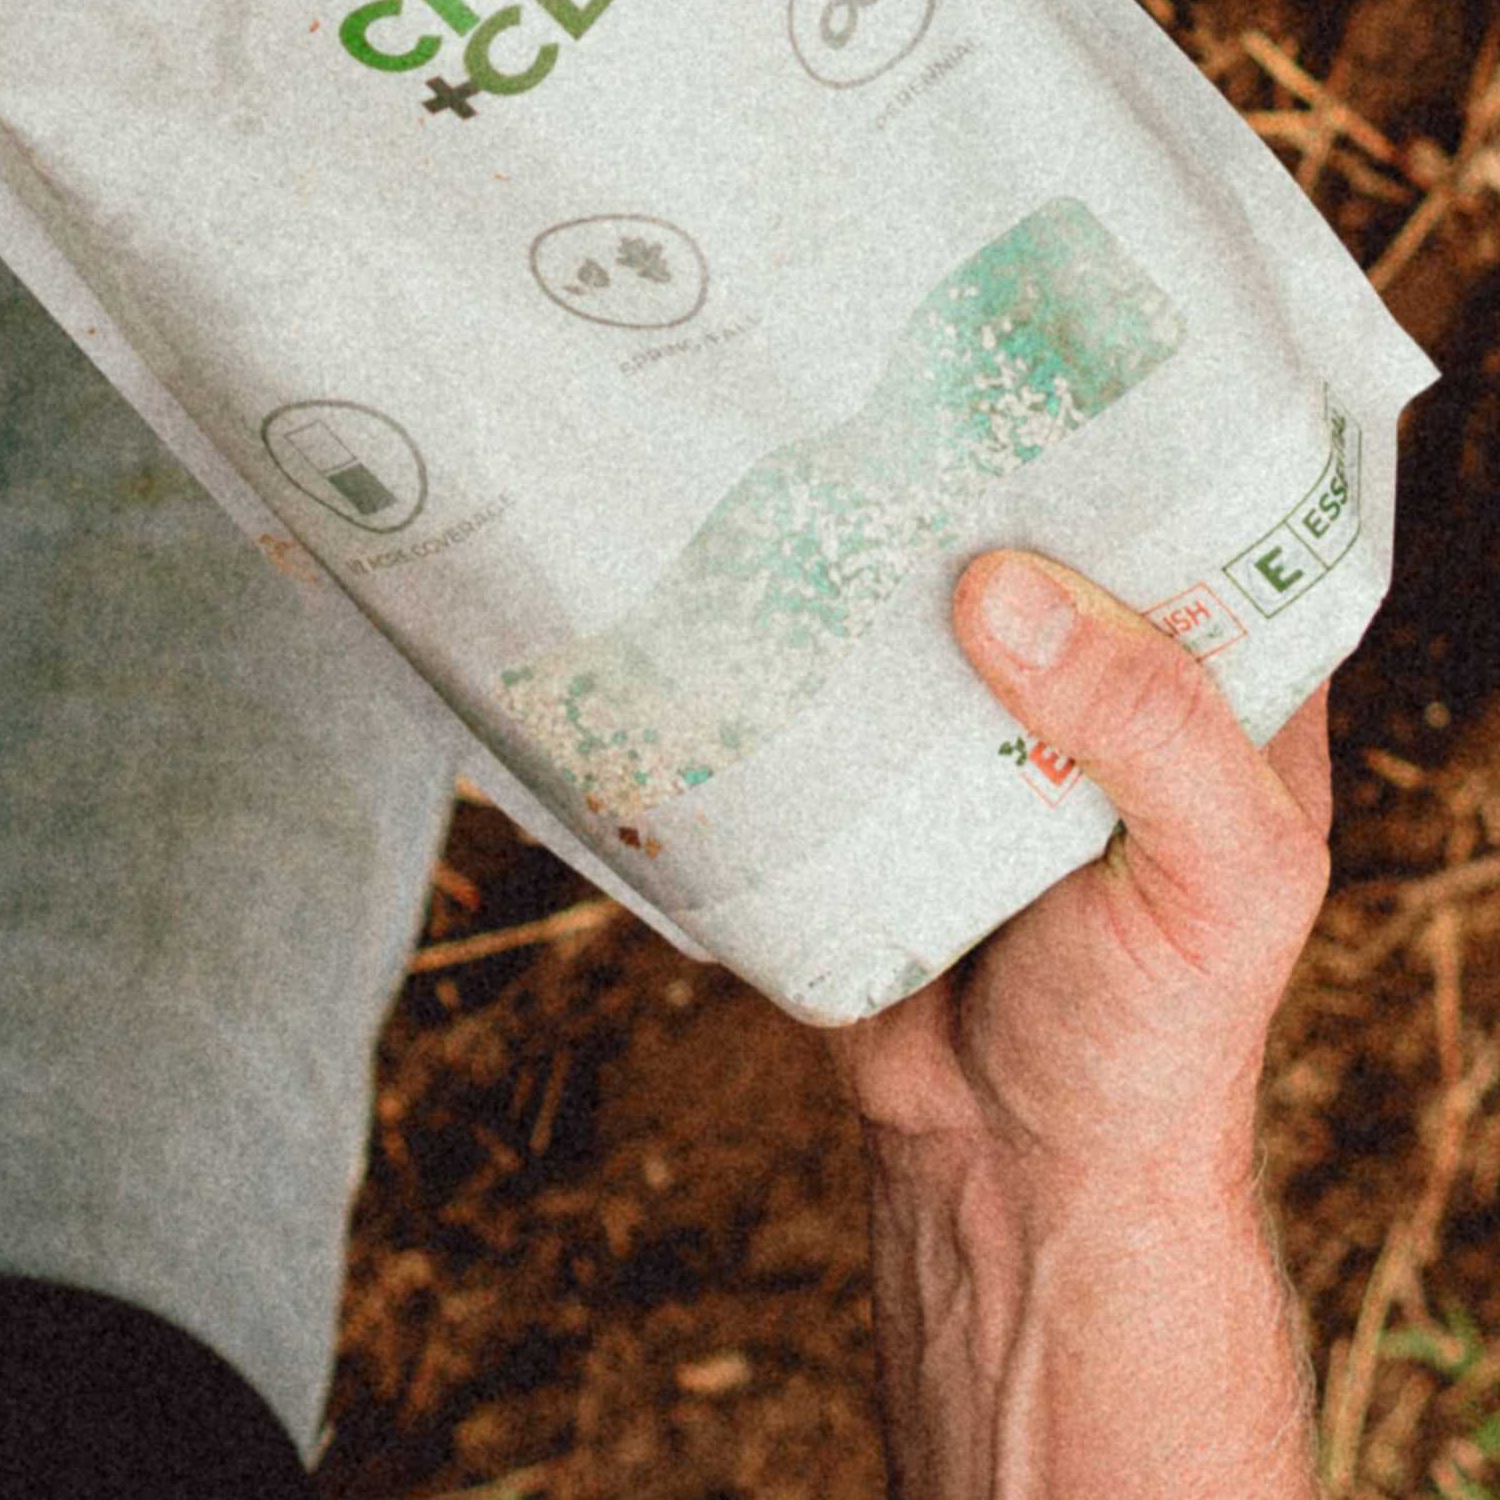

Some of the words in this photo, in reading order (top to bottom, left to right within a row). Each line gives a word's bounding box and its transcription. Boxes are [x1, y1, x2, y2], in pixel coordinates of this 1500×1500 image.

[874, 35, 984, 133] PERENNIAL
[411, 488, 516, 559] COVERAGE
[1254, 546, 1304, 593] E
